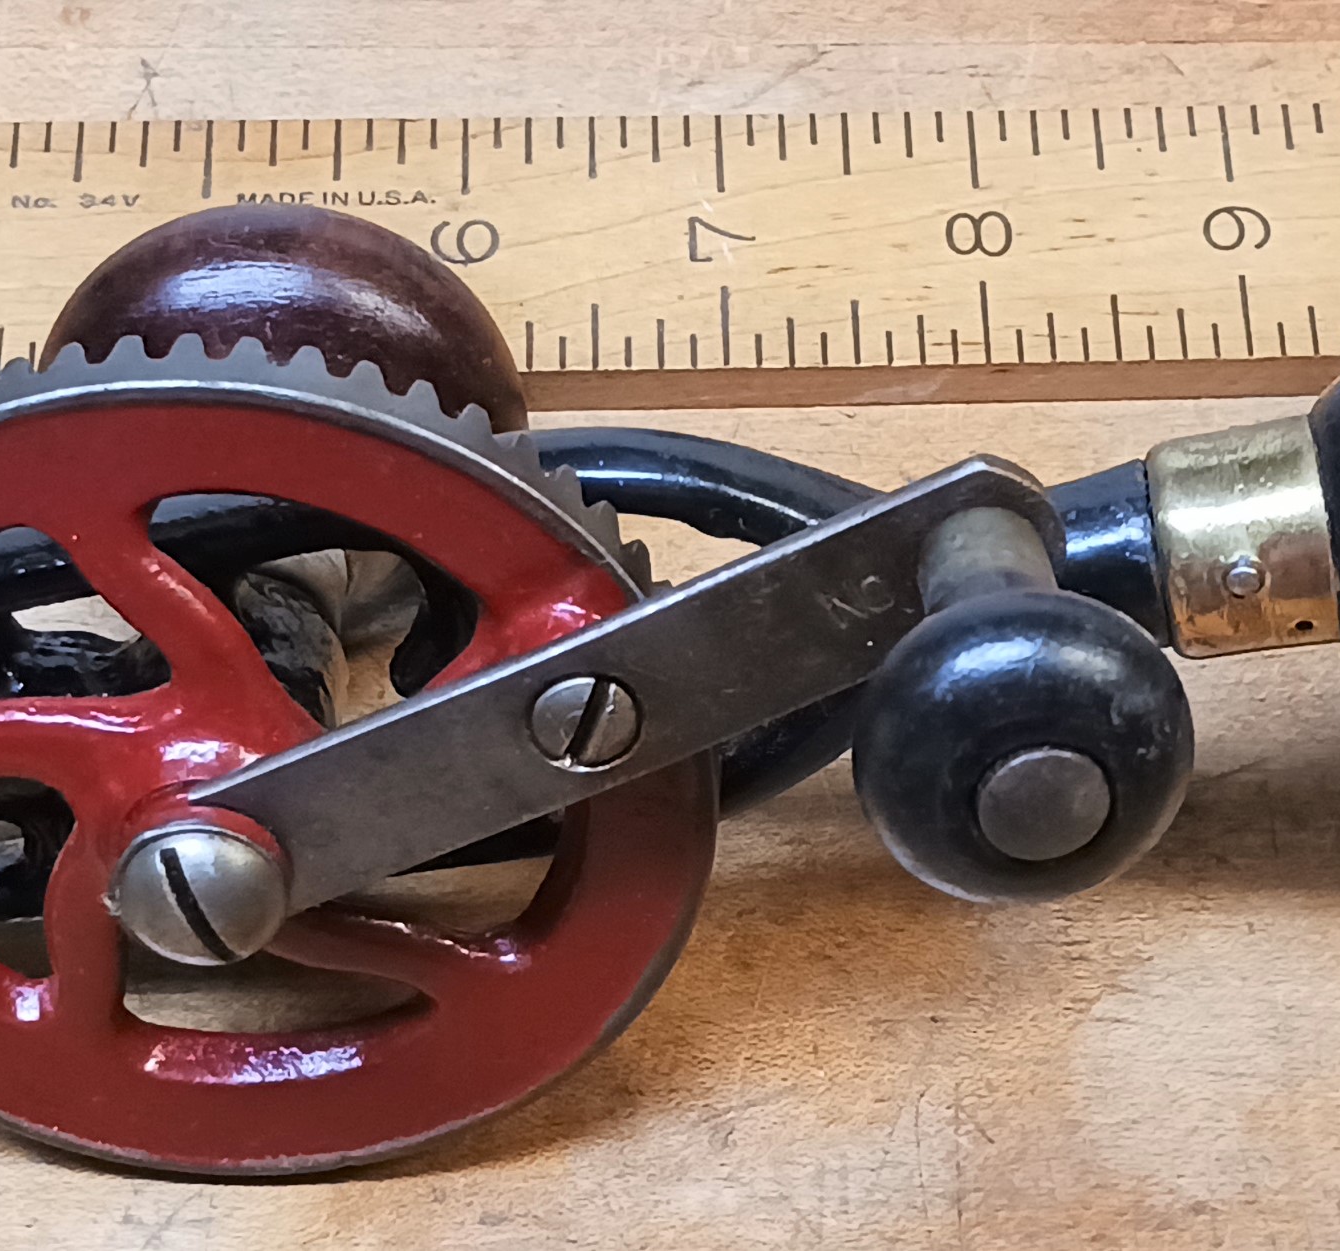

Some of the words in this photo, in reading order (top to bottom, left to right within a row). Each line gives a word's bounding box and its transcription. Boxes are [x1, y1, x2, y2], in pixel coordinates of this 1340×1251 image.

[236, 190, 315, 206] MADE
[322, 190, 350, 207] IN
[357, 189, 438, 207] U.S.A.
[430, 219, 500, 266] 6
[687, 215, 757, 263] 7
[944, 210, 1014, 258] 8
[1202, 205, 1272, 252] 9
